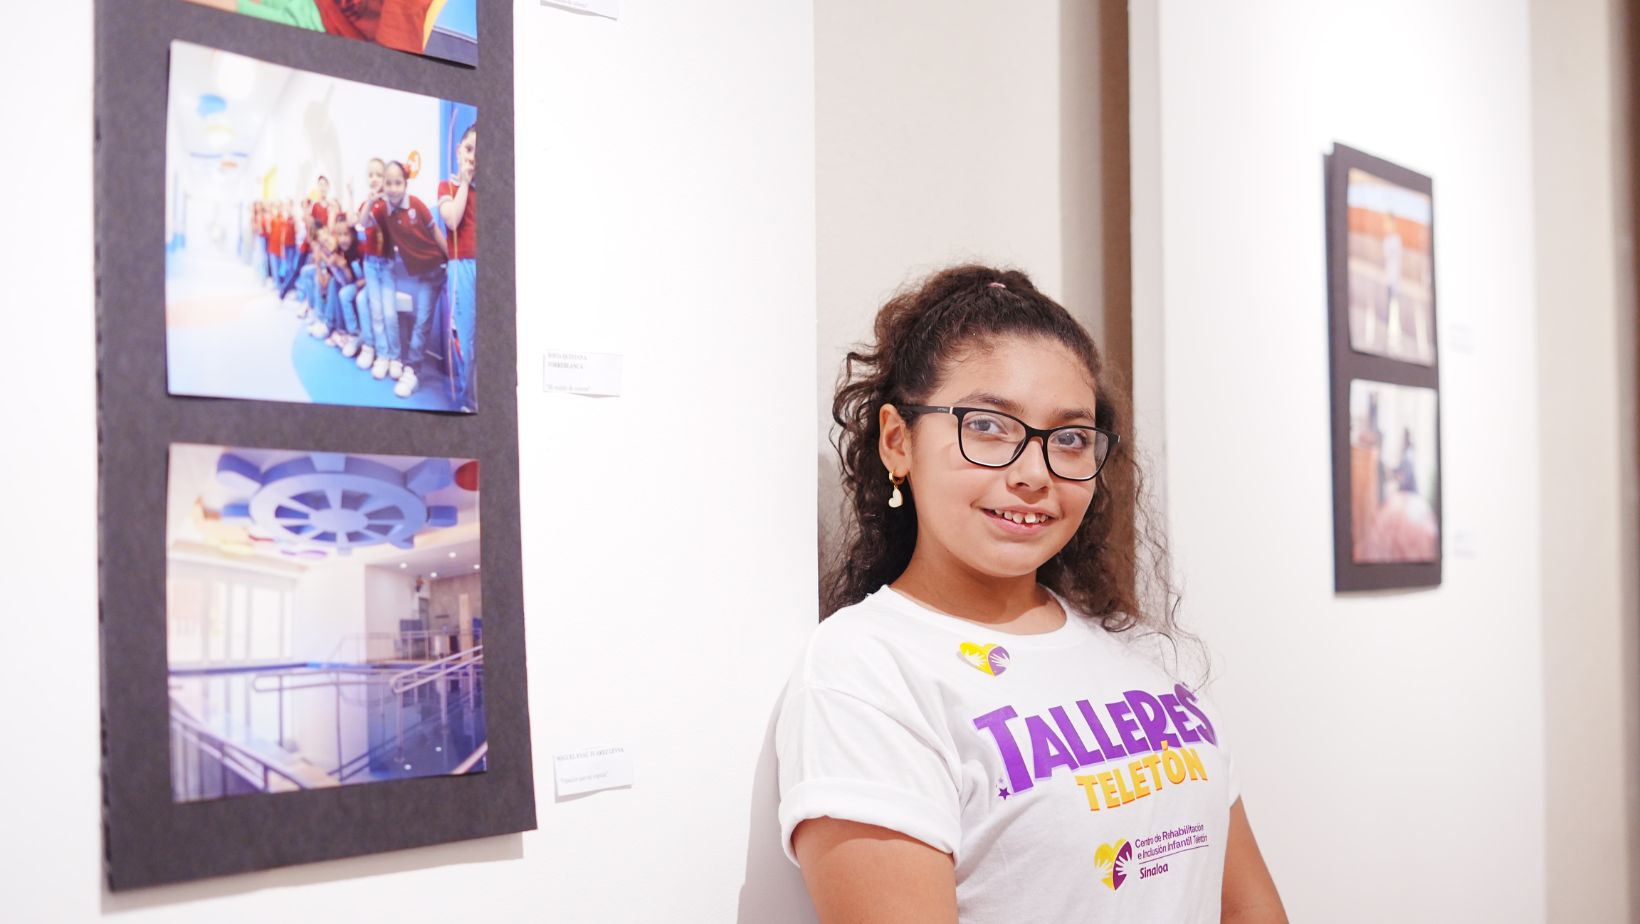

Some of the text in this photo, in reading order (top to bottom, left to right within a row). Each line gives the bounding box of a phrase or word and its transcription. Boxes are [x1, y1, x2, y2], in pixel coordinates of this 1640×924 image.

[973, 683, 1217, 794] TALLERES
[1075, 740, 1208, 812] TELETÓN
[1135, 837, 1154, 848] Centro
[1154, 834, 1161, 842] de
[1137, 852, 1142, 860] e
[1167, 835, 1193, 851] Infantil
[1140, 863, 1168, 879] Sinaloa
